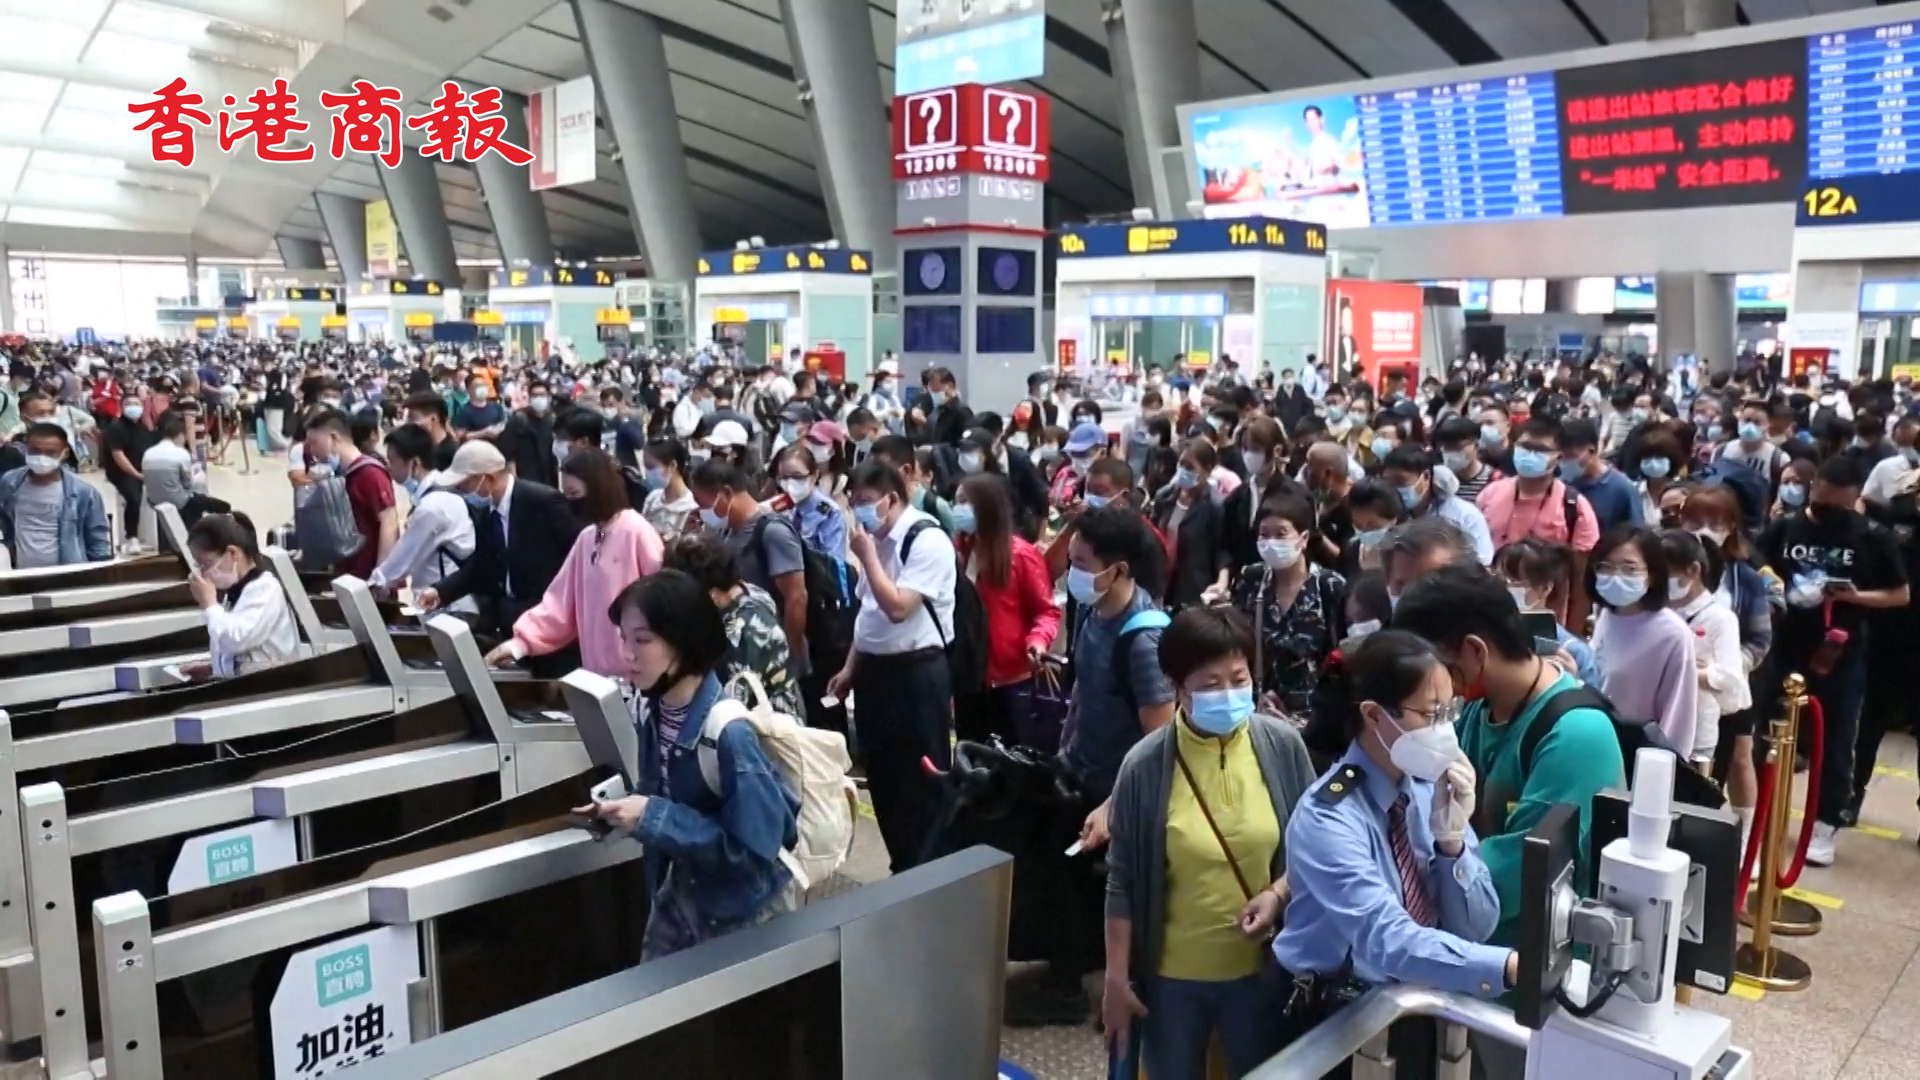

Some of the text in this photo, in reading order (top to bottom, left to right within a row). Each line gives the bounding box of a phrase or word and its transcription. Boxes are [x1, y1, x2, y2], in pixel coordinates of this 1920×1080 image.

[905, 153, 957, 174] 12306
[984, 153, 1036, 176] 12306
[1803, 187, 1858, 216] 12A
[1059, 233, 1085, 253] 10A
[1229, 223, 1258, 245] 11A
[1265, 224, 1285, 245] 11A
[1305, 229, 1324, 249] 11A
[212, 841, 248, 860] BOSS
[322, 953, 364, 977] BOSS
